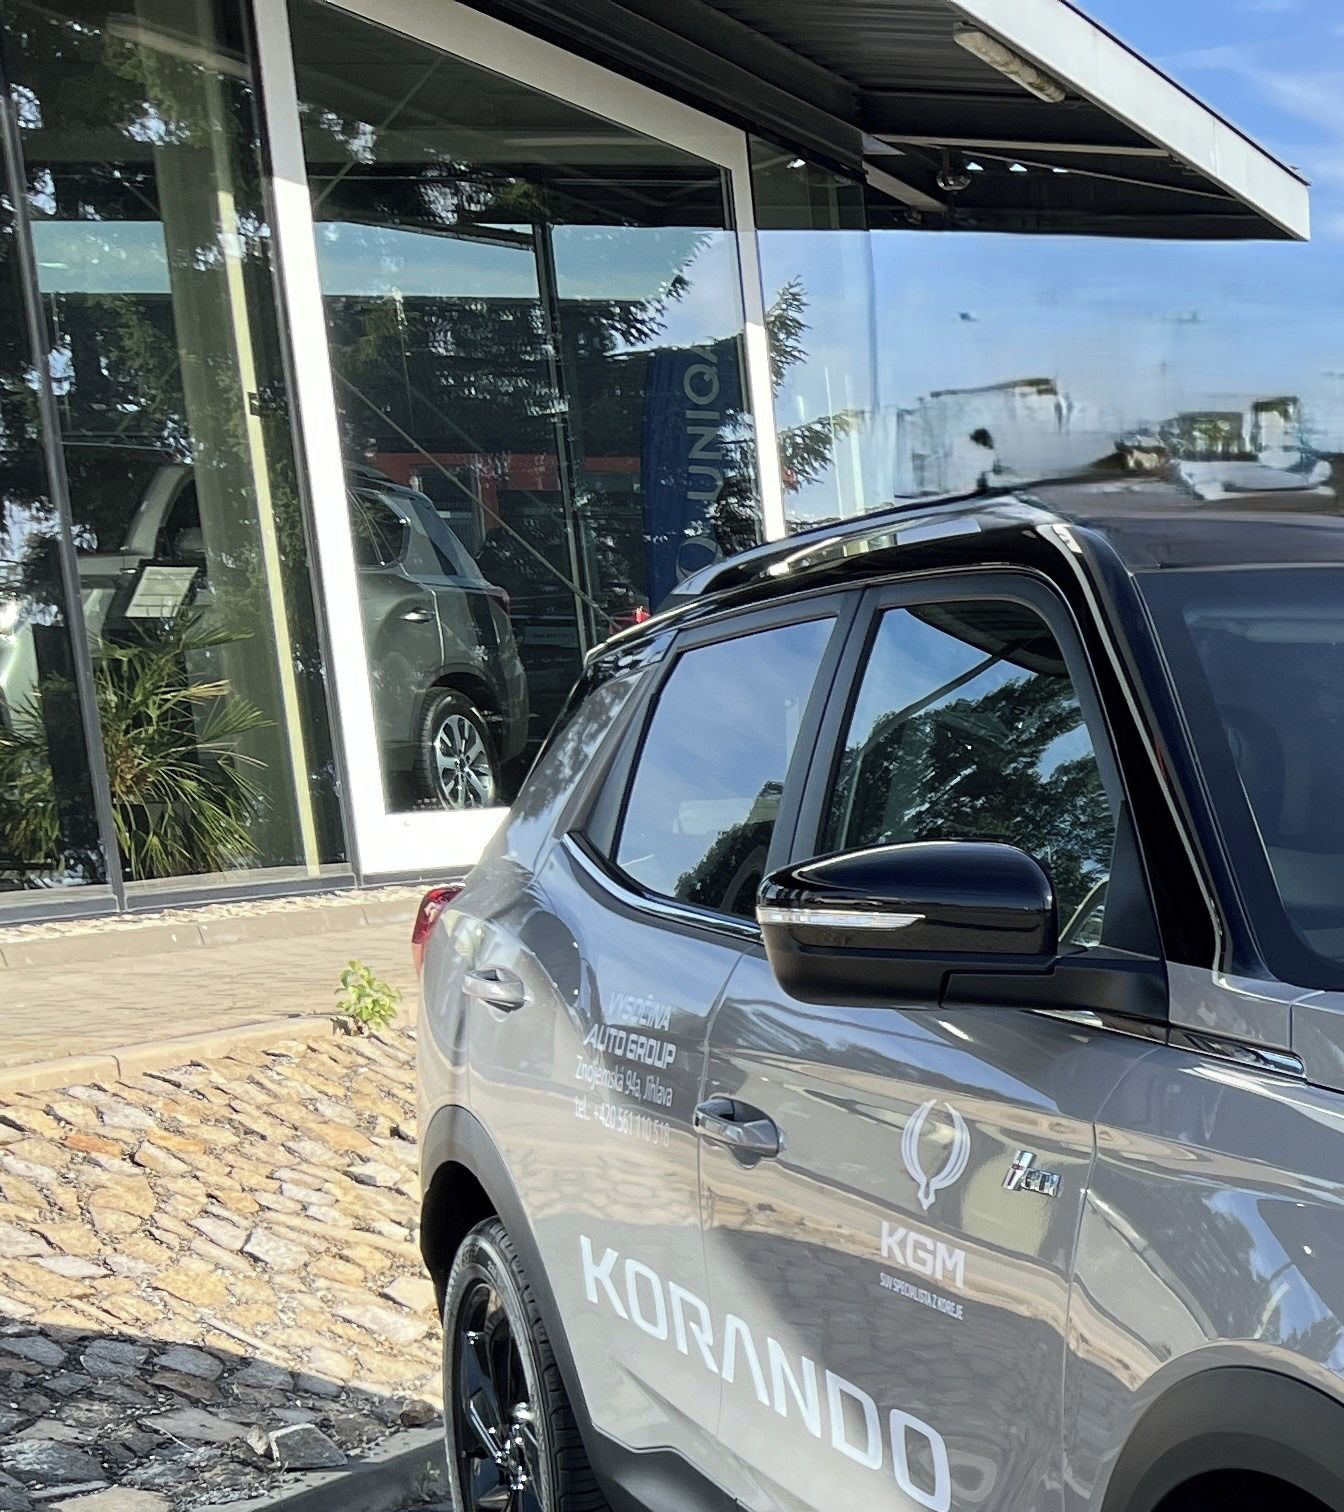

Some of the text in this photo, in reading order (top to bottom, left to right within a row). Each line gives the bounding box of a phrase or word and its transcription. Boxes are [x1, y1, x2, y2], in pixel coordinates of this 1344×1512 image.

[609, 992, 673, 1032] VYSOČINA
[583, 1023, 677, 1070] AUTO GROUP
[880, 1220, 966, 1289] KGM
